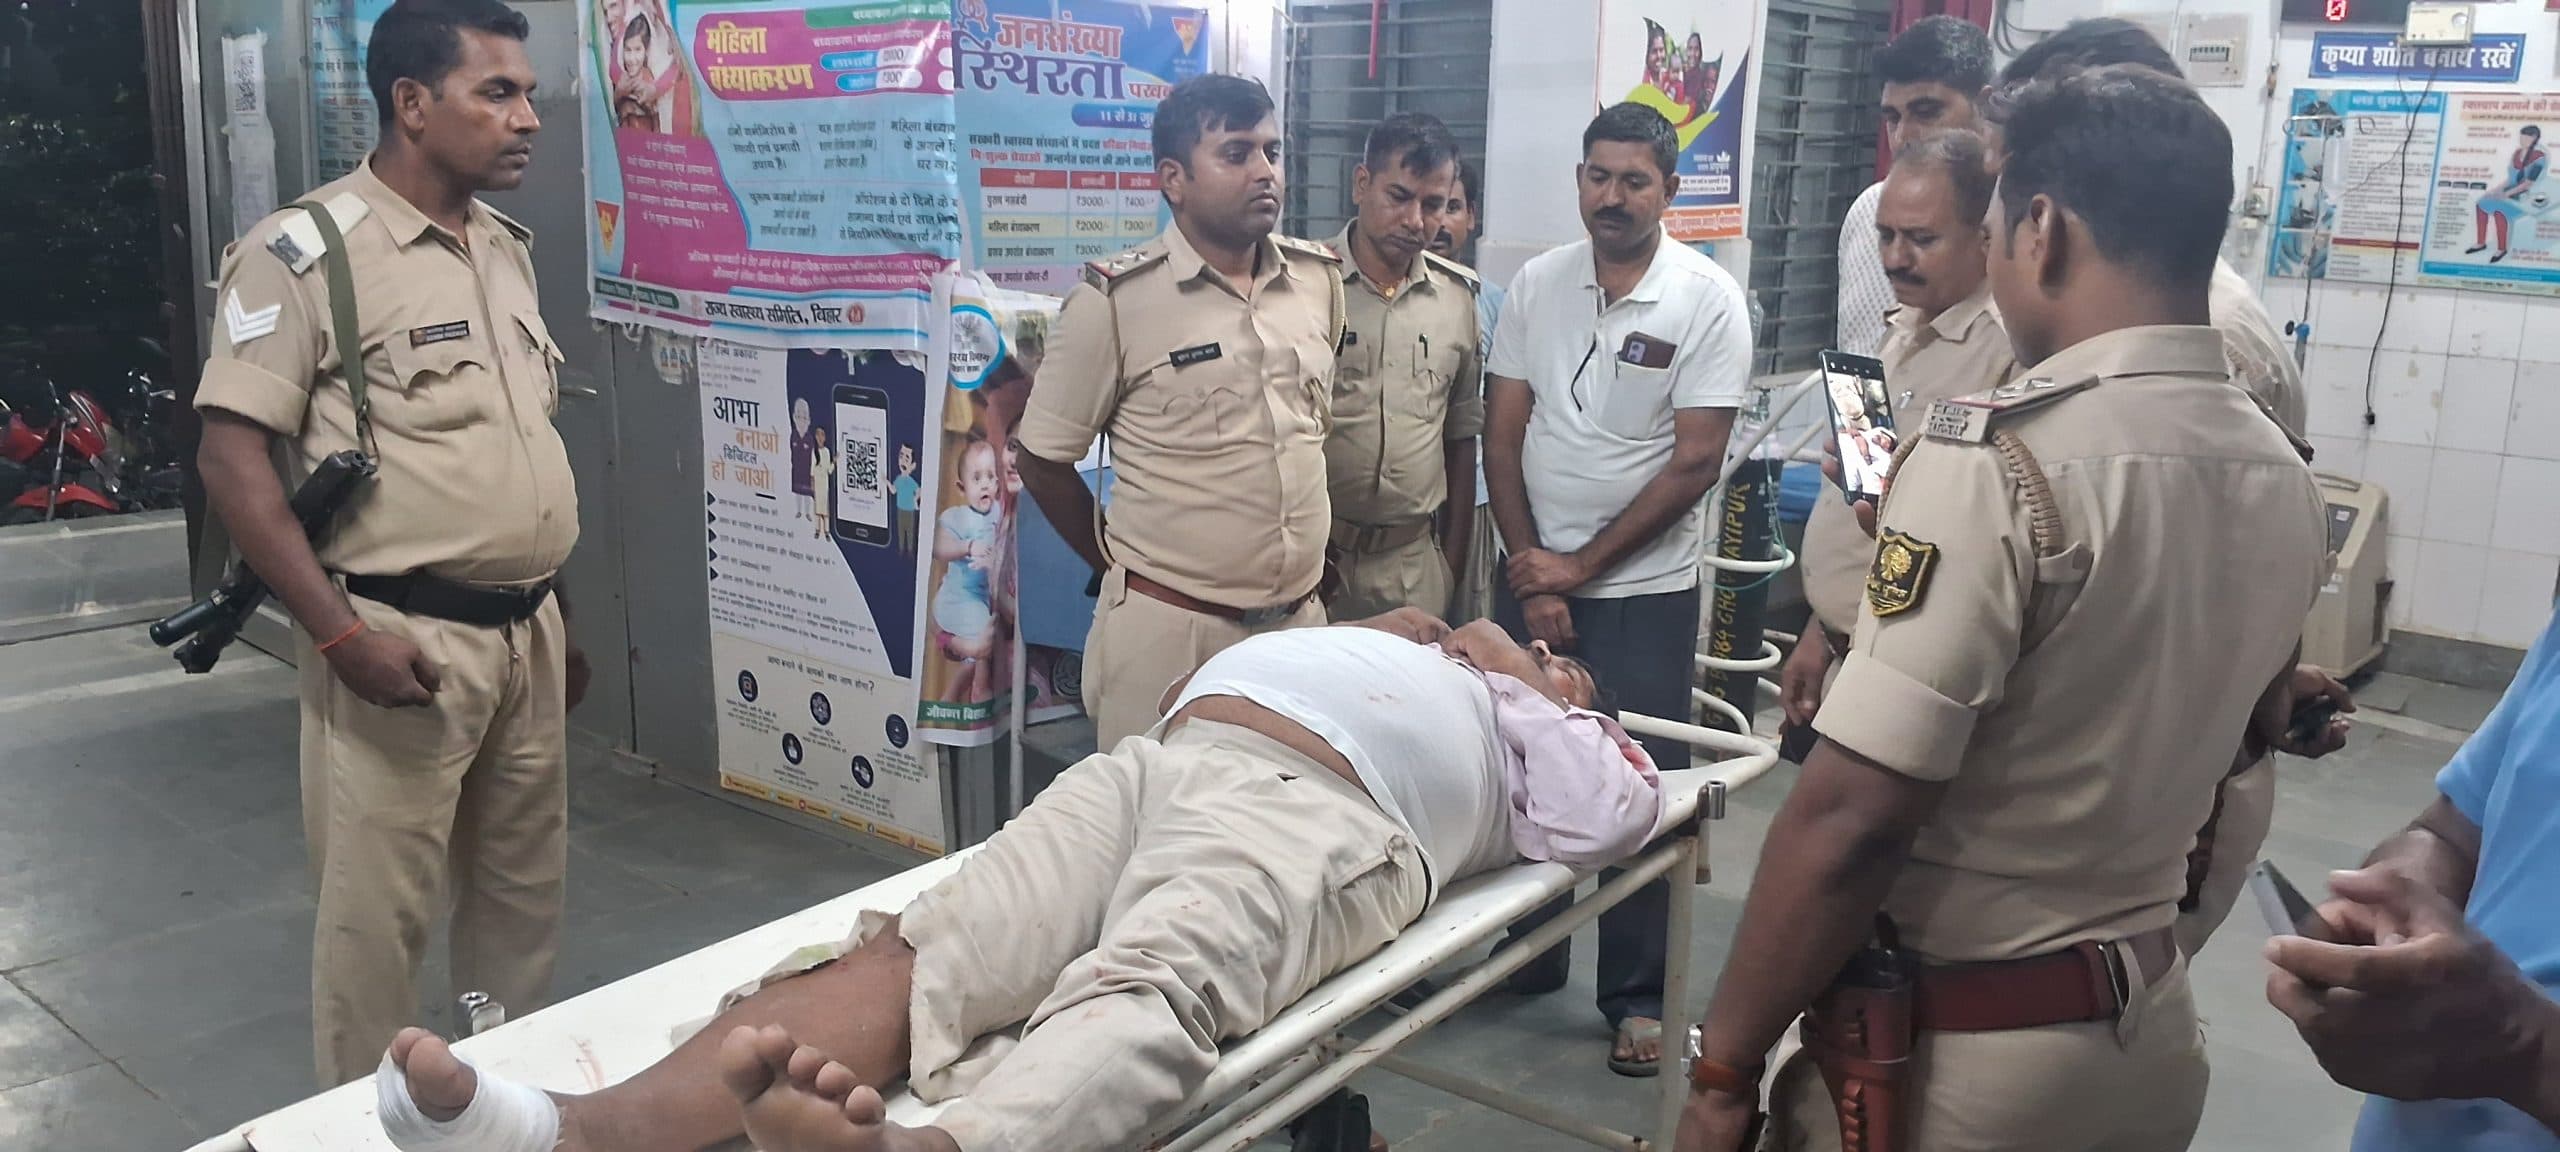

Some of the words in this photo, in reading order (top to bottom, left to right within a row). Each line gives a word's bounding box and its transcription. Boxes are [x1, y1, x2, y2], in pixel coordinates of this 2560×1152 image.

[705, 20, 767, 54] महिला
[993, 10, 1124, 59] जनसंख्या
[953, 30, 1126, 100] स्थिरता
[2481, 42, 2517, 68] रखें
[707, 57, 814, 92] बंध्याकरण
[1115, 109, 1126, 122] से
[705, 300, 728, 316] राज्य
[728, 303, 765, 320] स्वास्थ्य
[810, 303, 842, 324] बिहार
[713, 396, 760, 428] आभा
[723, 443, 758, 465] डिजिटल
[735, 425, 779, 455] बनाओ
[711, 455, 726, 481] हो
